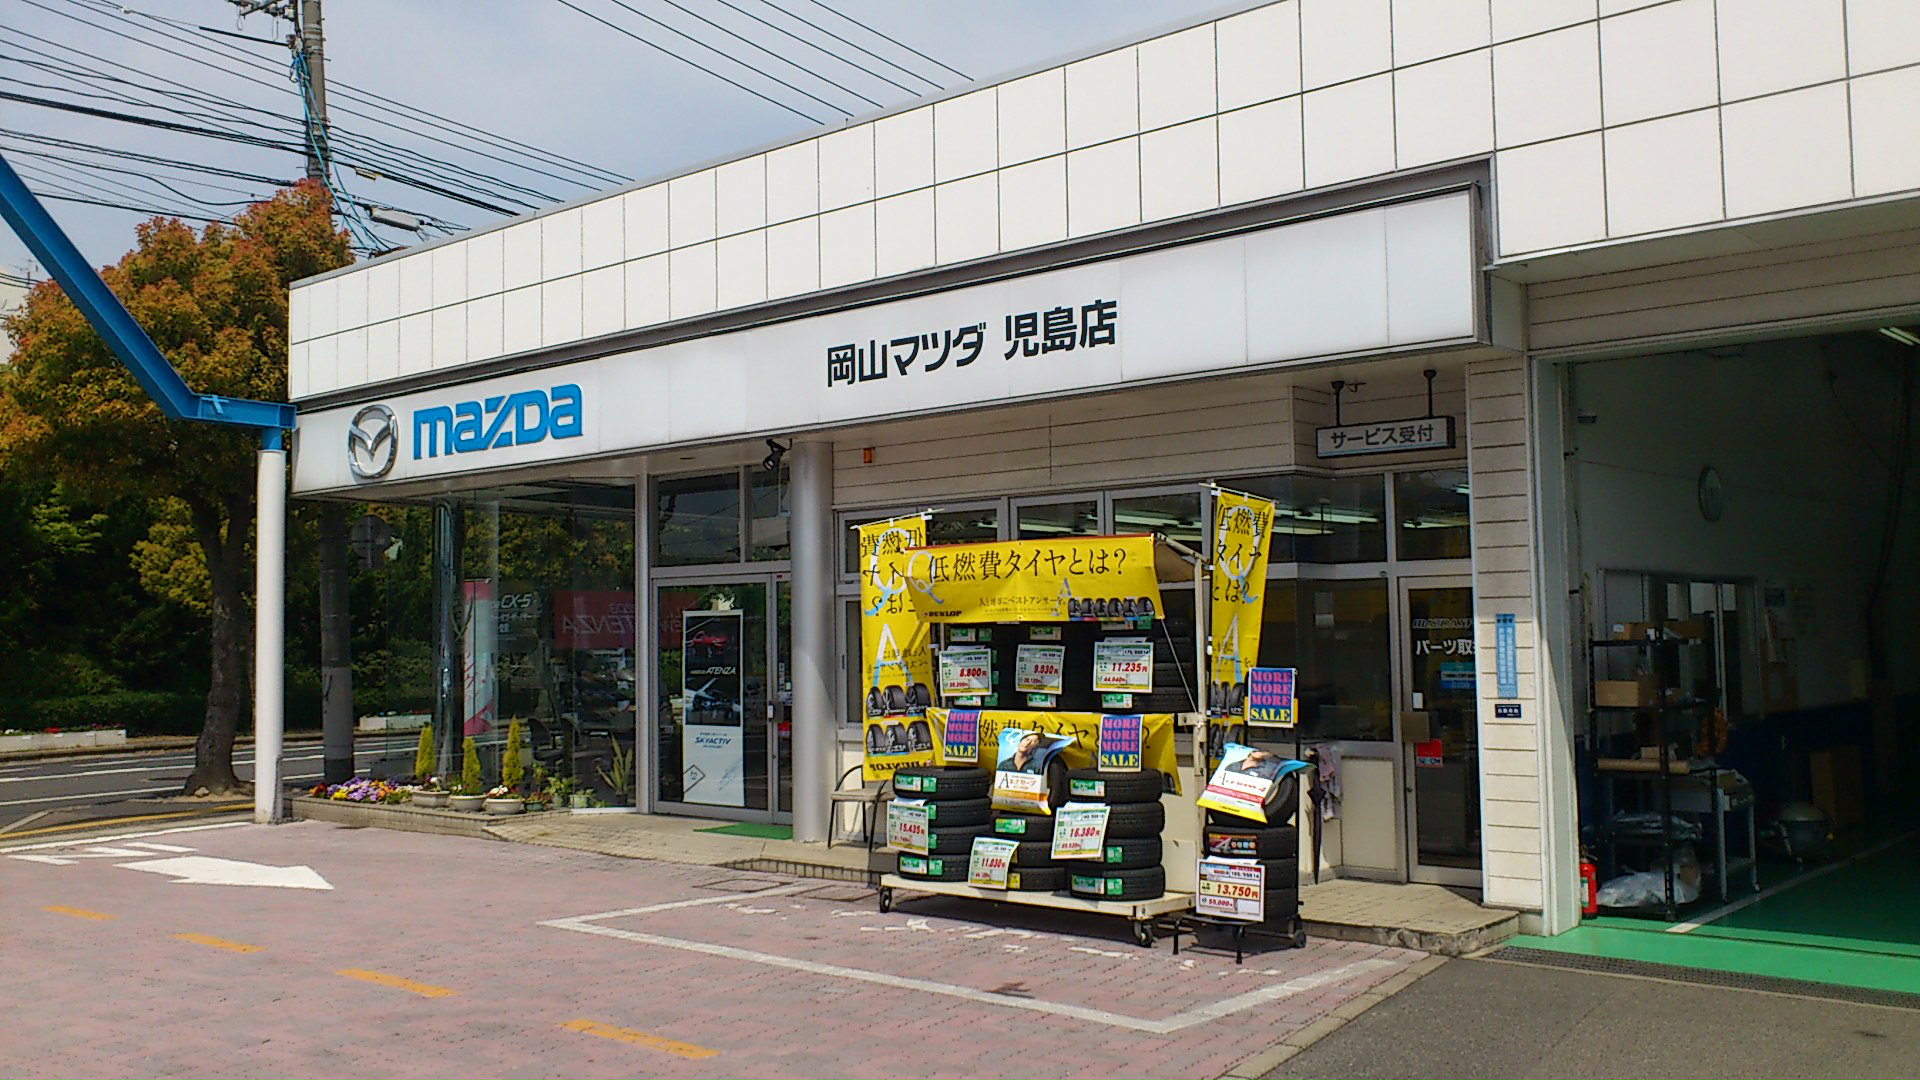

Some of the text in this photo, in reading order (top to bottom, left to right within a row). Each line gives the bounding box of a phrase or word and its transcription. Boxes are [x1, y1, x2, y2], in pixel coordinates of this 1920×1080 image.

[827, 298, 1117, 388] 岡山マツダ 児島店
[1330, 424, 1434, 449] サービス受付
[1217, 503, 1270, 538] 低燃費
[927, 547, 1127, 584] 低燃費タイヤとは?
[501, 592, 532, 608] CX-5
[929, 610, 962, 618] DUNLOP
[1415, 639, 1475, 656] パーツ取
[706, 666, 737, 675] ATENZA
[1251, 671, 1291, 682] MORE
[1251, 683, 1291, 694] MORE
[1250, 695, 1290, 707] MORE
[949, 712, 978, 722] MORE
[1250, 708, 1291, 721] SALE
[948, 723, 977, 733] MORE
[1104, 718, 1140, 729] MORE
[947, 733, 976, 743] MORE
[1103, 729, 1139, 740] MORE
[694, 736, 732, 745] SKYACTIV
[945, 745, 976, 757] SALE
[1102, 741, 1139, 752] MORE
[1101, 753, 1138, 766] SALE
